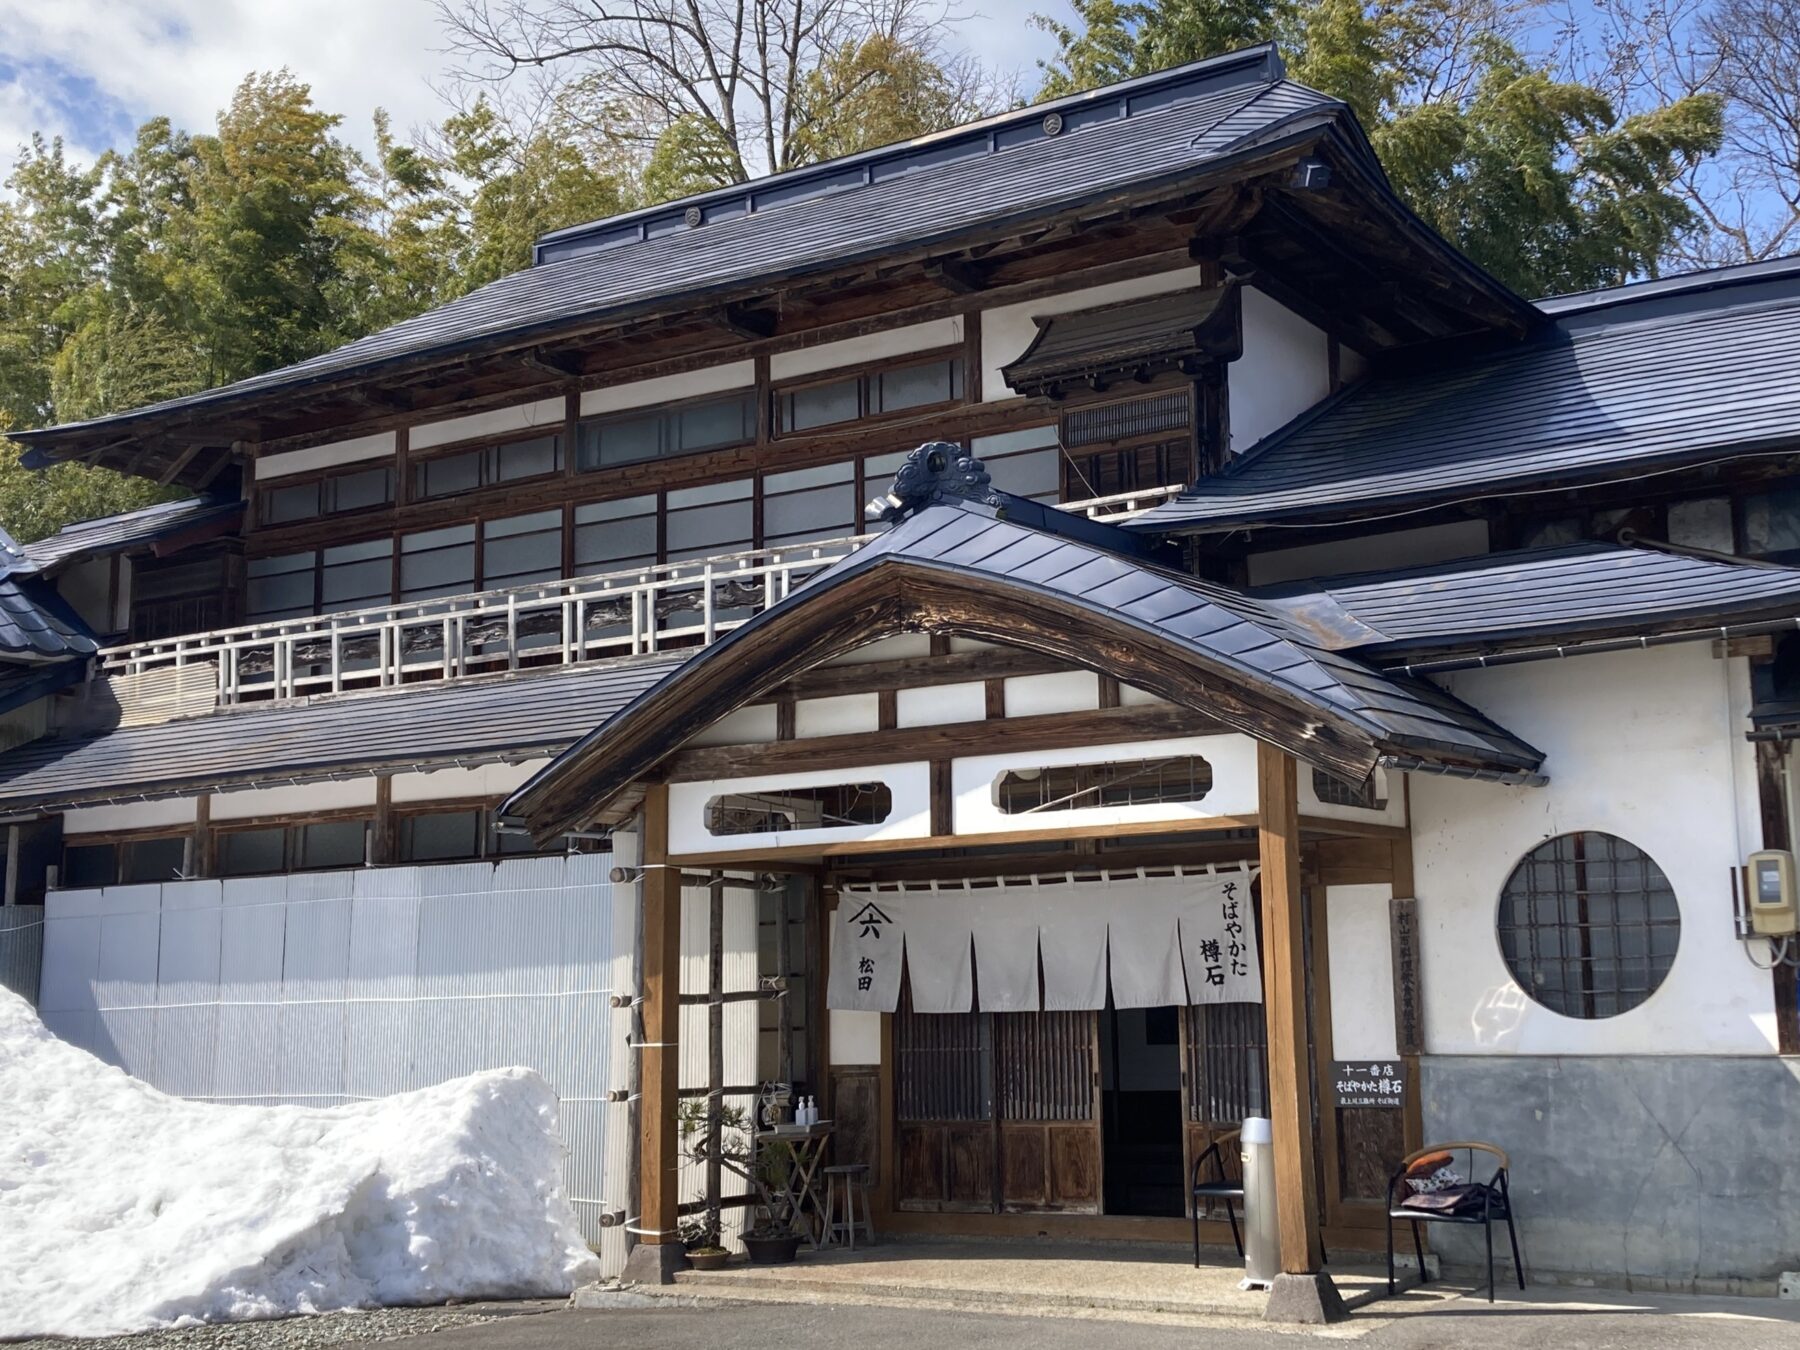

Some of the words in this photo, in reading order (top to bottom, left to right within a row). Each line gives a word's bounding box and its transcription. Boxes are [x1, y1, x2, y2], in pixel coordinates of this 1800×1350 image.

[1222, 882, 1247, 976] そばやかた
[858, 956, 875, 992] 松田
[1200, 939, 1225, 986] 樽石
[1336, 1078, 1402, 1095] そばやかた樽石
[1342, 1064, 1394, 1077] 十一番店
